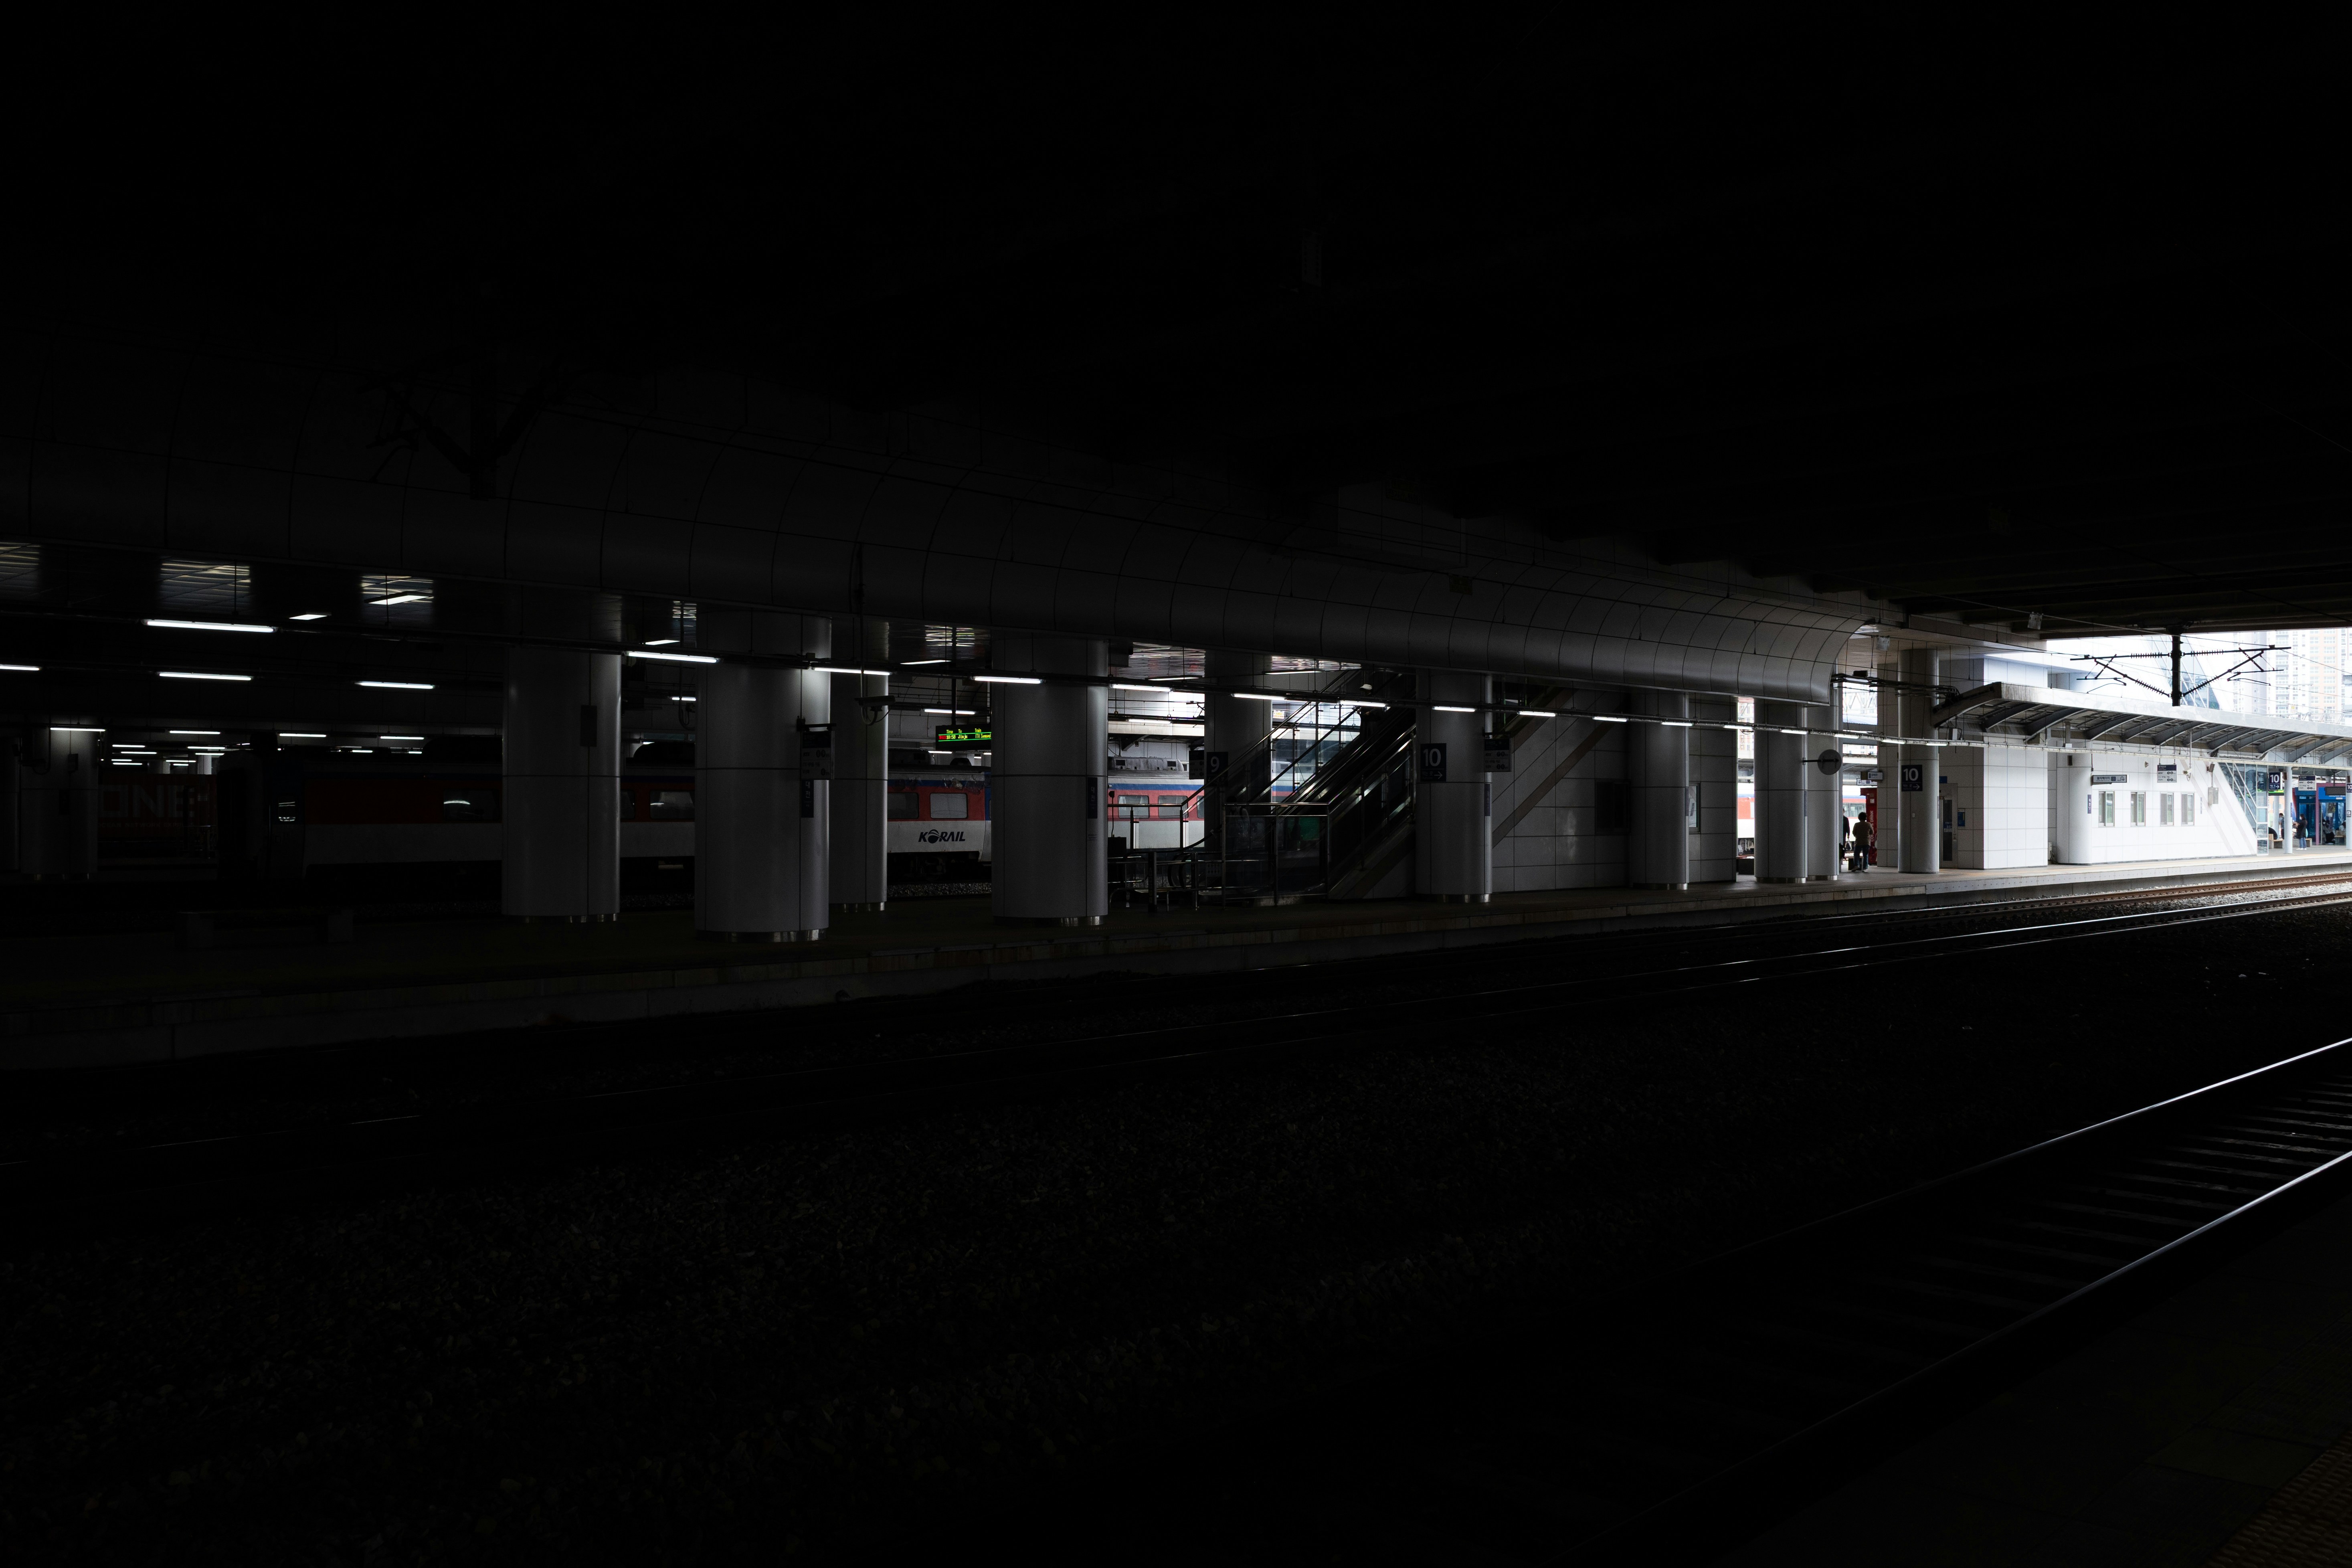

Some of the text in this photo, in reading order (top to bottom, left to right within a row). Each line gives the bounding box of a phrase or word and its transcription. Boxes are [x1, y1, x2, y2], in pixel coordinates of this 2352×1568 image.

[1211, 756, 1219, 773] 9
[1423, 748, 1441, 767] 10
[1903, 768, 1919, 781] 10
[2270, 775, 2279, 783] 10
[805, 781, 810, 798] 대전
[918, 829, 965, 844] KORAIL
